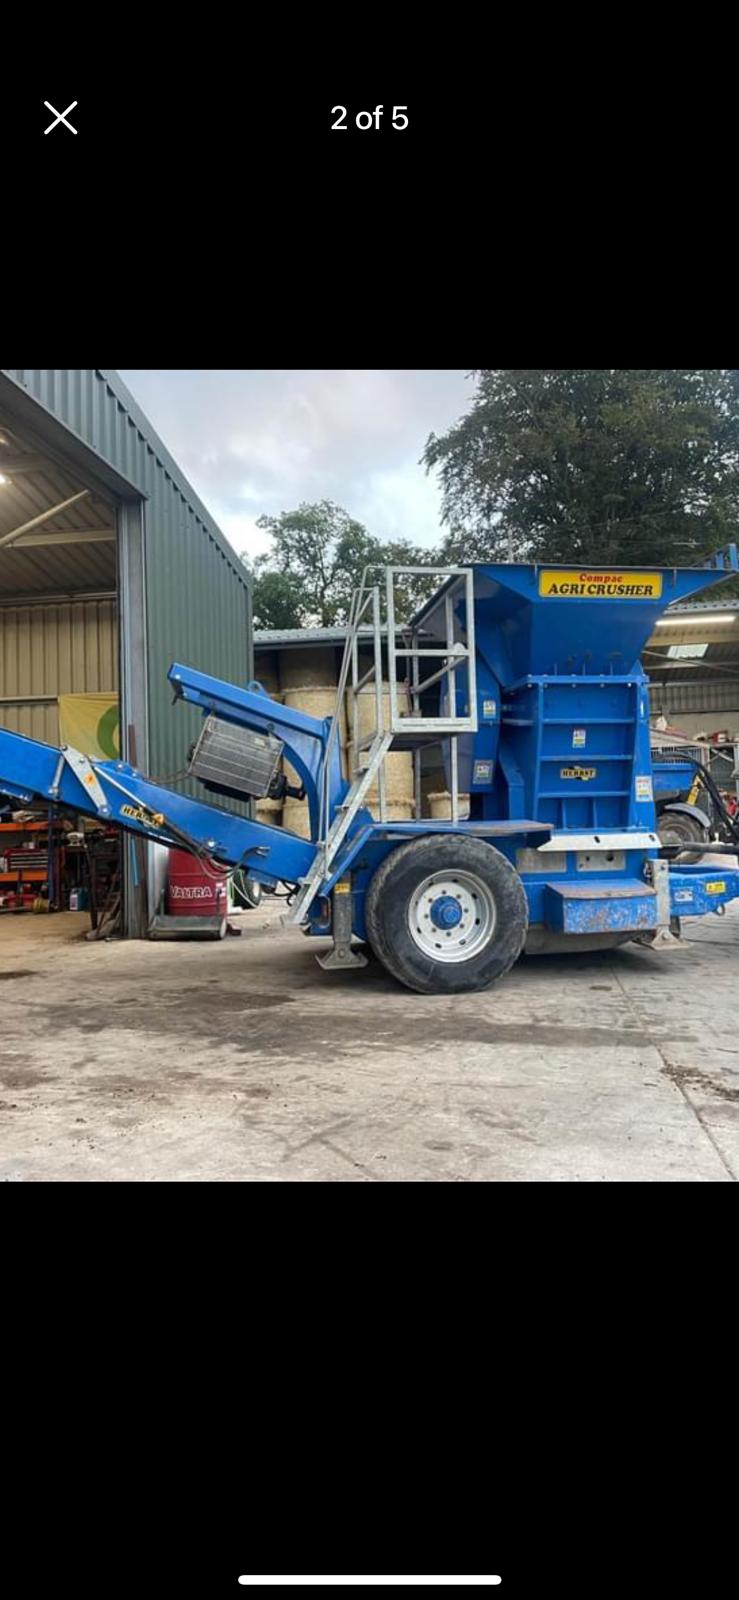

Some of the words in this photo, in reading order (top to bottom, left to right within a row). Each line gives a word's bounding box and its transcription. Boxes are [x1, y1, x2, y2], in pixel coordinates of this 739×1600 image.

[579, 573, 623, 583] Compac
[548, 583, 585, 594] AGRI
[587, 584, 653, 595] CRUSHER
[170, 886, 213, 899] VALTRA
